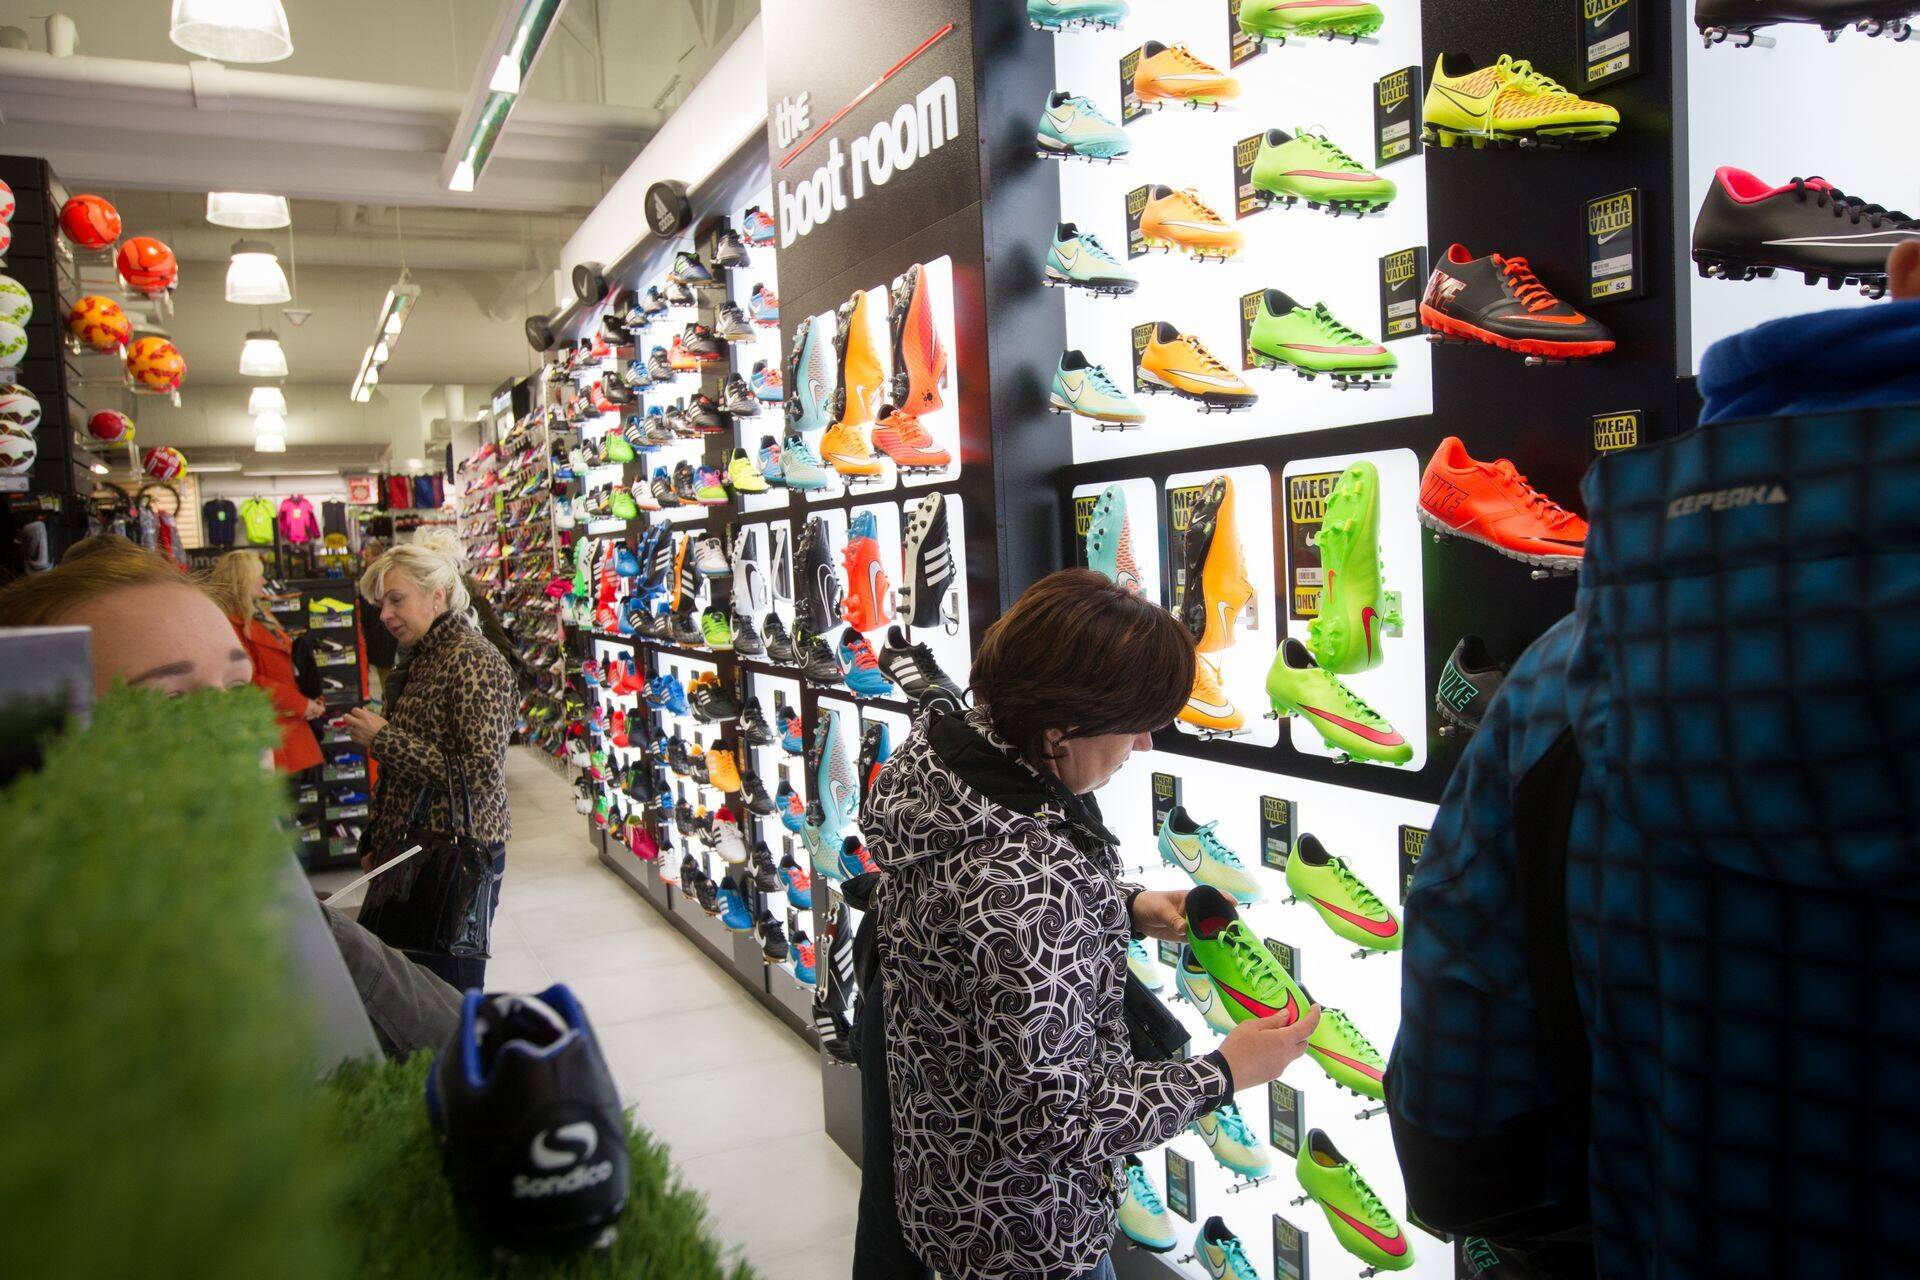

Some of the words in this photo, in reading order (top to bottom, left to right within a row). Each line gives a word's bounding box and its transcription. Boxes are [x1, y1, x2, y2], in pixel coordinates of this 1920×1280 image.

[1586, 0, 1628, 17] VALU
[1589, 66, 1605, 79] ONLY
[1613, 61, 1623, 70] 40
[775, 90, 810, 149] the
[777, 137, 848, 249] boot
[850, 75, 959, 200] room
[1239, 149, 1259, 164] VALU
[1590, 198, 1630, 219] MEGA
[1590, 211, 1631, 232] VALUE
[1385, 252, 1414, 270] MEGA
[1386, 264, 1416, 281] VALUE
[1592, 284, 1608, 295] ONLY
[1615, 282, 1626, 291] 52
[1244, 295, 1261, 308] MEG
[1245, 305, 1260, 318] VAL
[1596, 418, 1635, 434] MEGA
[1596, 431, 1636, 447] VALUE
[1077, 499, 1096, 516] ME
[1174, 490, 1201, 509] MEG
[1294, 501, 1328, 519] VAL
[1296, 594, 1317, 610] ONLY
[1265, 799, 1287, 812] MEGA
[1265, 810, 1289, 823] VALUE
[1407, 830, 1428, 844] MEG
